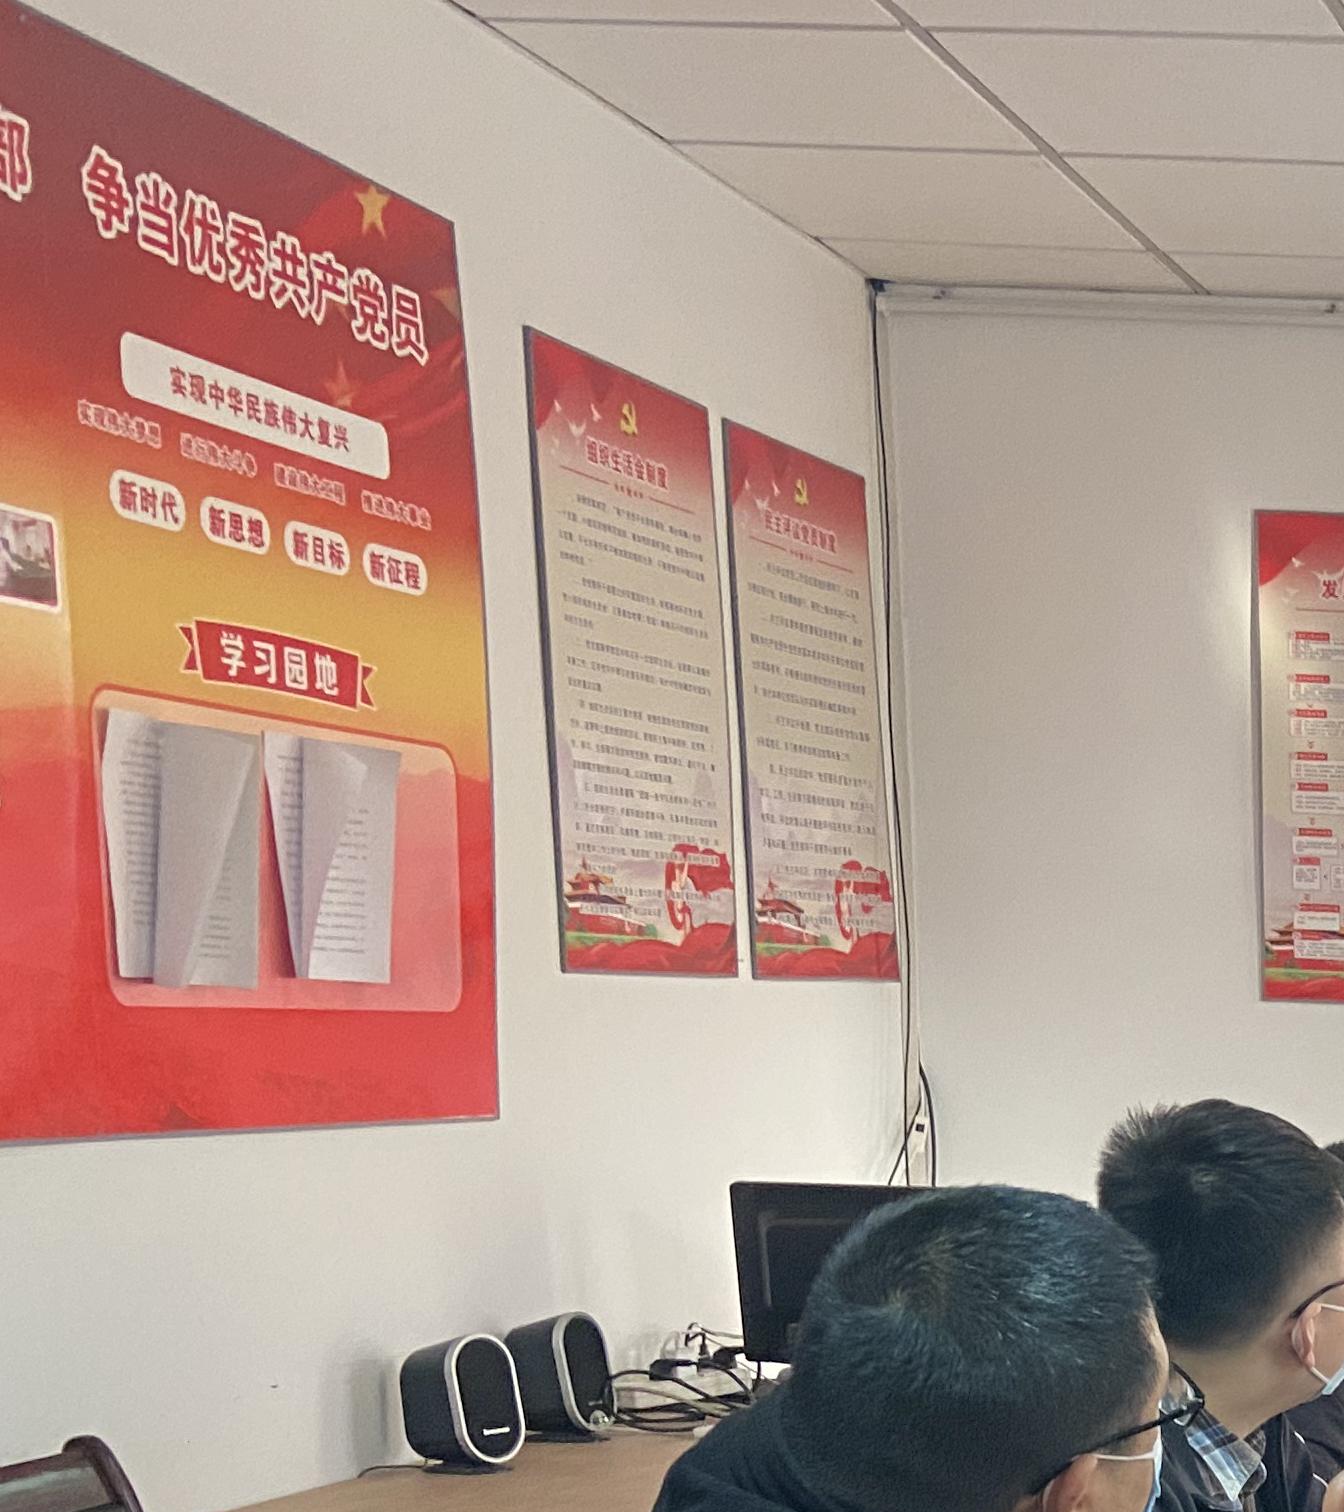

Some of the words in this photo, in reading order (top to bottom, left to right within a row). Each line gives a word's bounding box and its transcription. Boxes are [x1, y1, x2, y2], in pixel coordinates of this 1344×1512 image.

[81, 144, 430, 367] 争当优秀共产党员
[170, 364, 350, 453] 实现中华民族伟大复兴
[117, 478, 181, 525] 新时代
[207, 507, 266, 549] 新思想
[292, 529, 346, 571] 新目标
[368, 550, 421, 592] 新征程
[218, 630, 340, 698] 学习园地
